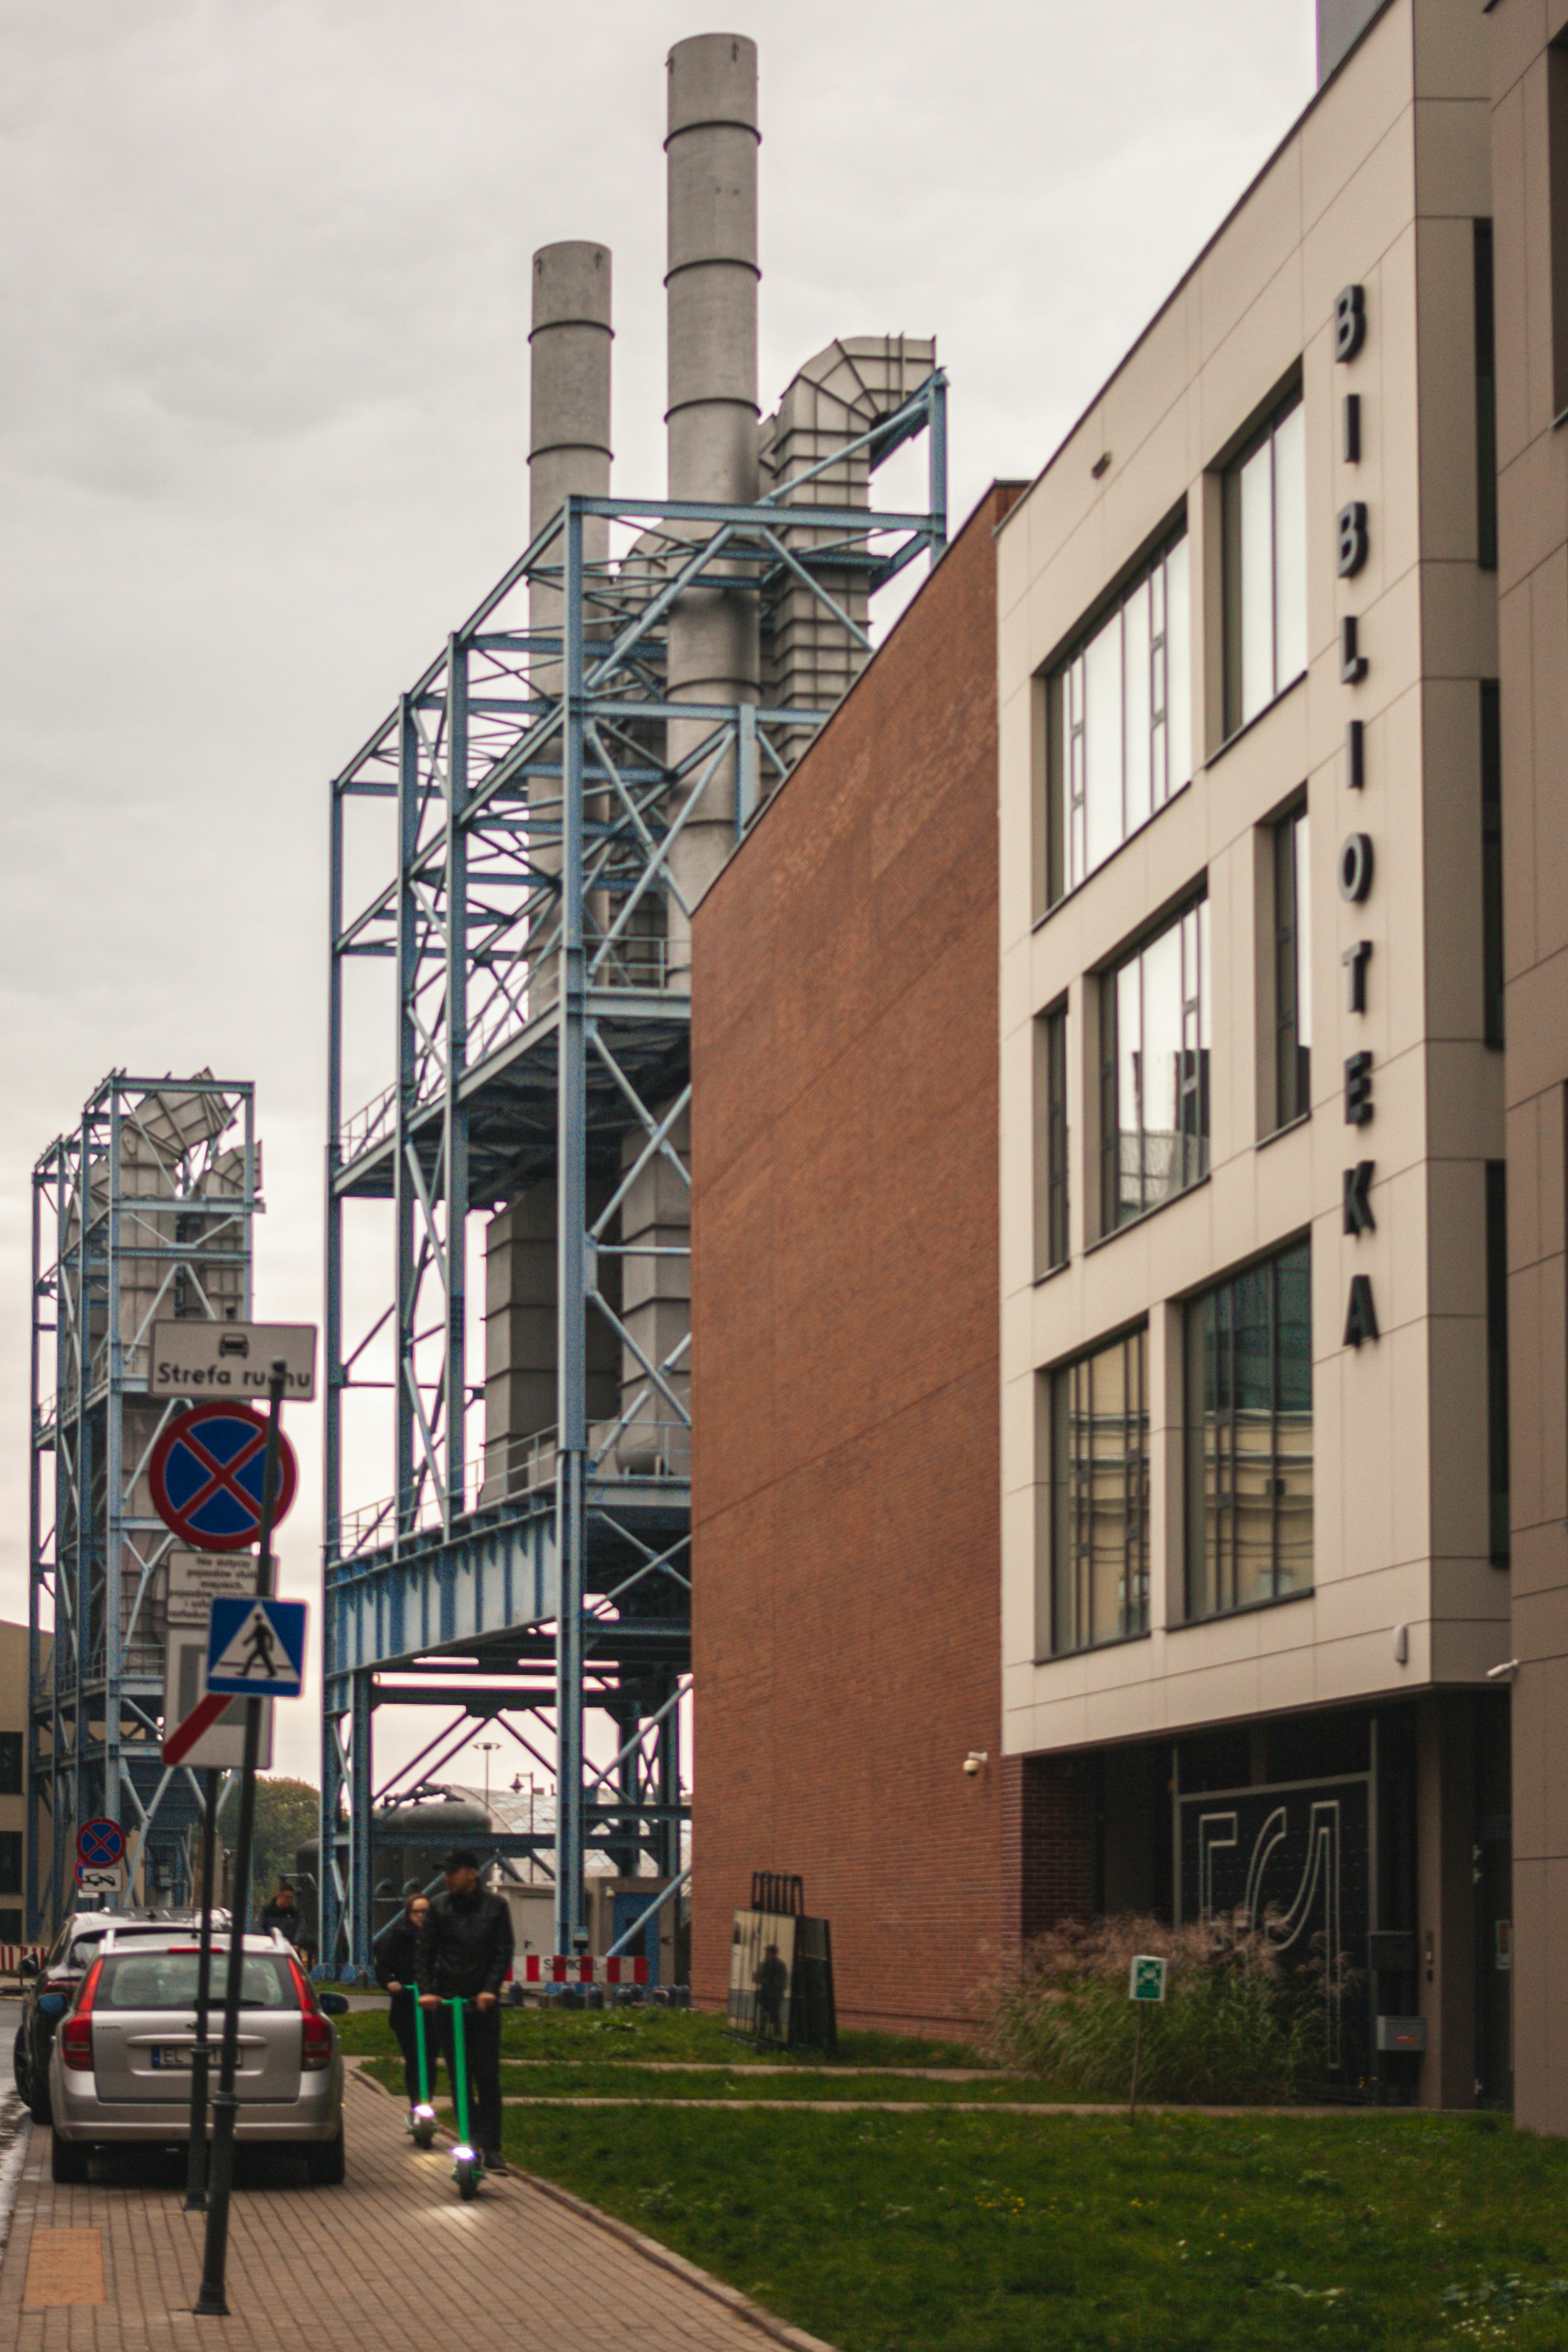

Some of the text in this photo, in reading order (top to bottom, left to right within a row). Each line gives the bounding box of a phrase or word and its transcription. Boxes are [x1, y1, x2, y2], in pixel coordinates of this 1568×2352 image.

[1334, 284, 1380, 1348] BIBLIOTEKA
[158, 1362, 231, 1385] Strefa
[163, 2047, 183, 2063] EL
